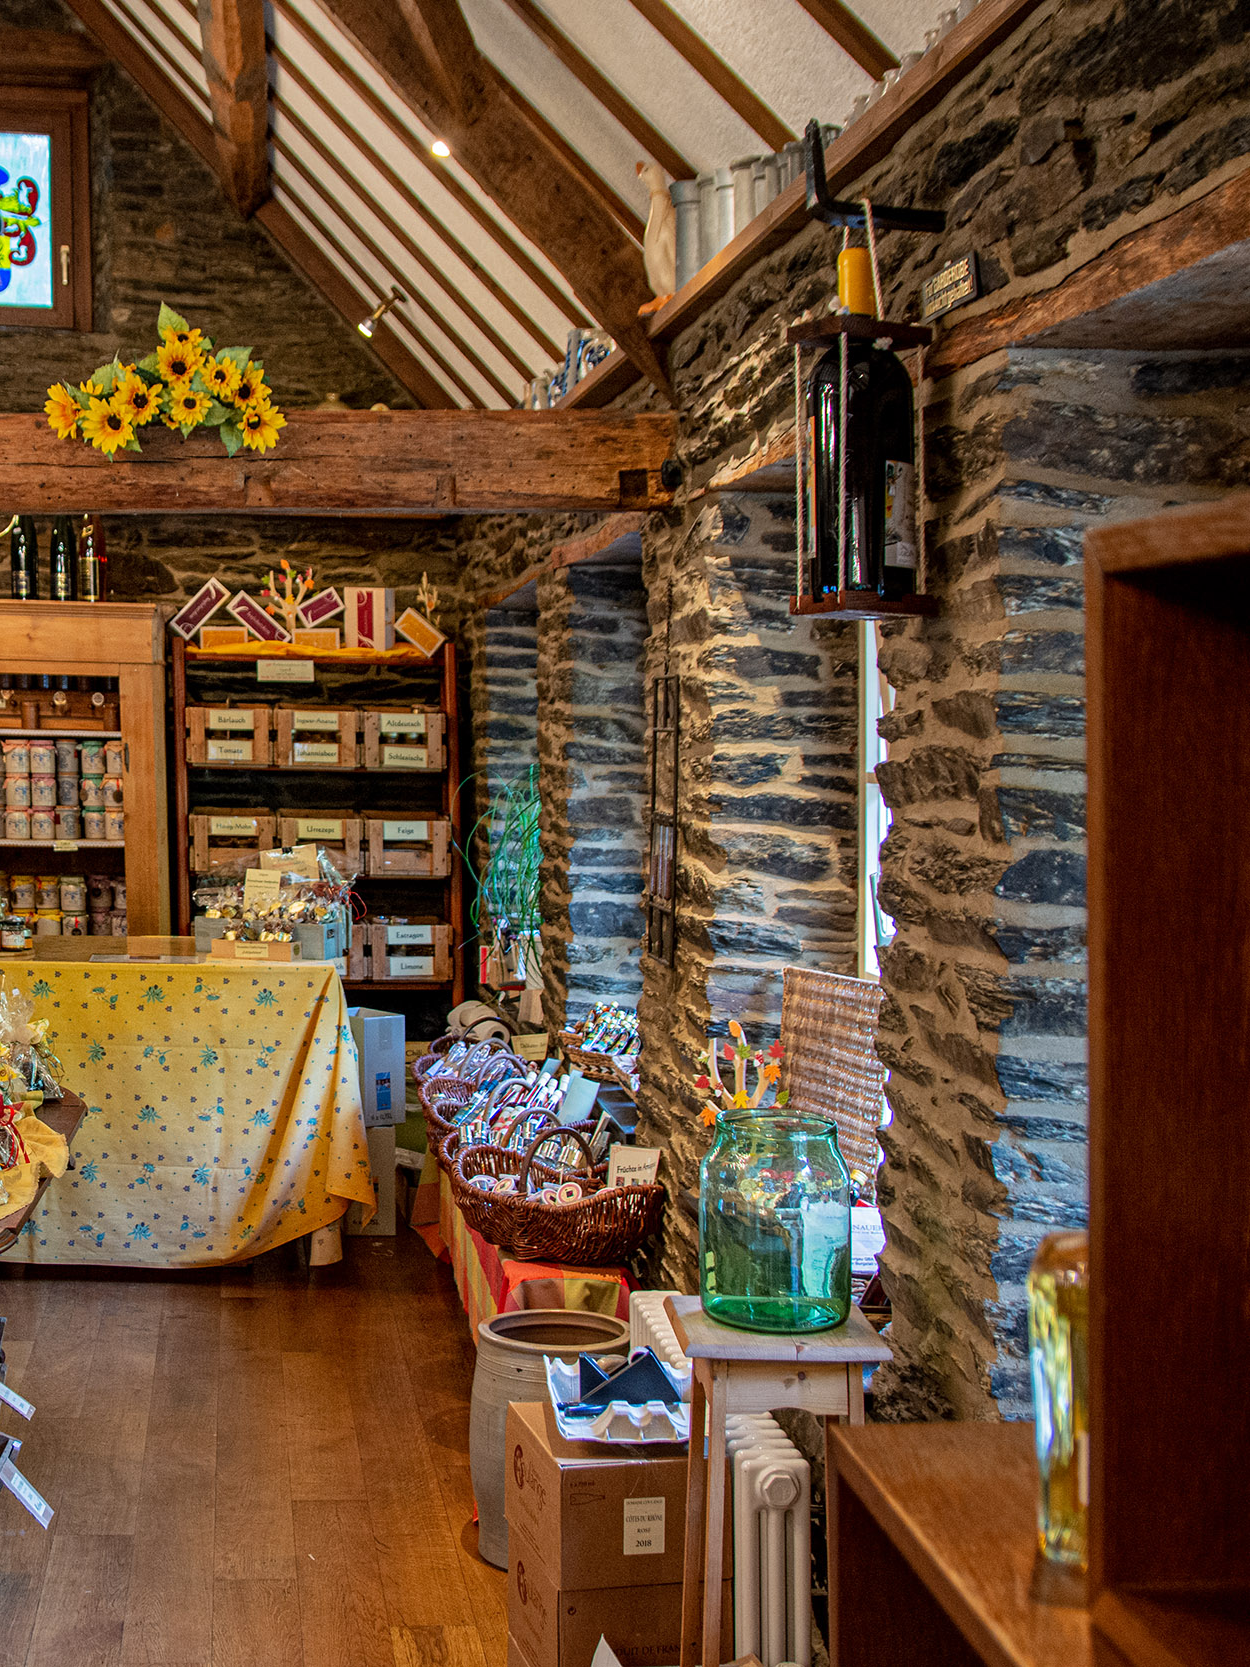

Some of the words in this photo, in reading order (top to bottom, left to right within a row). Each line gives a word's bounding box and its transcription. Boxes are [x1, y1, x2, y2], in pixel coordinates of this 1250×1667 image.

[386, 719, 422, 728] Altdeutsch
[218, 747, 243, 755] Tomate
[297, 749, 337, 758] Johannisbeer
[388, 752, 424, 762] Schlesische
[397, 826, 414, 836] Feige
[396, 931, 424, 940] Estragon
[400, 962, 423, 970] Limone
[616, 1165, 637, 1174] Früchte
[635, 1539, 652, 1547] 2018
[655, 1644, 681, 1654] FRAN
